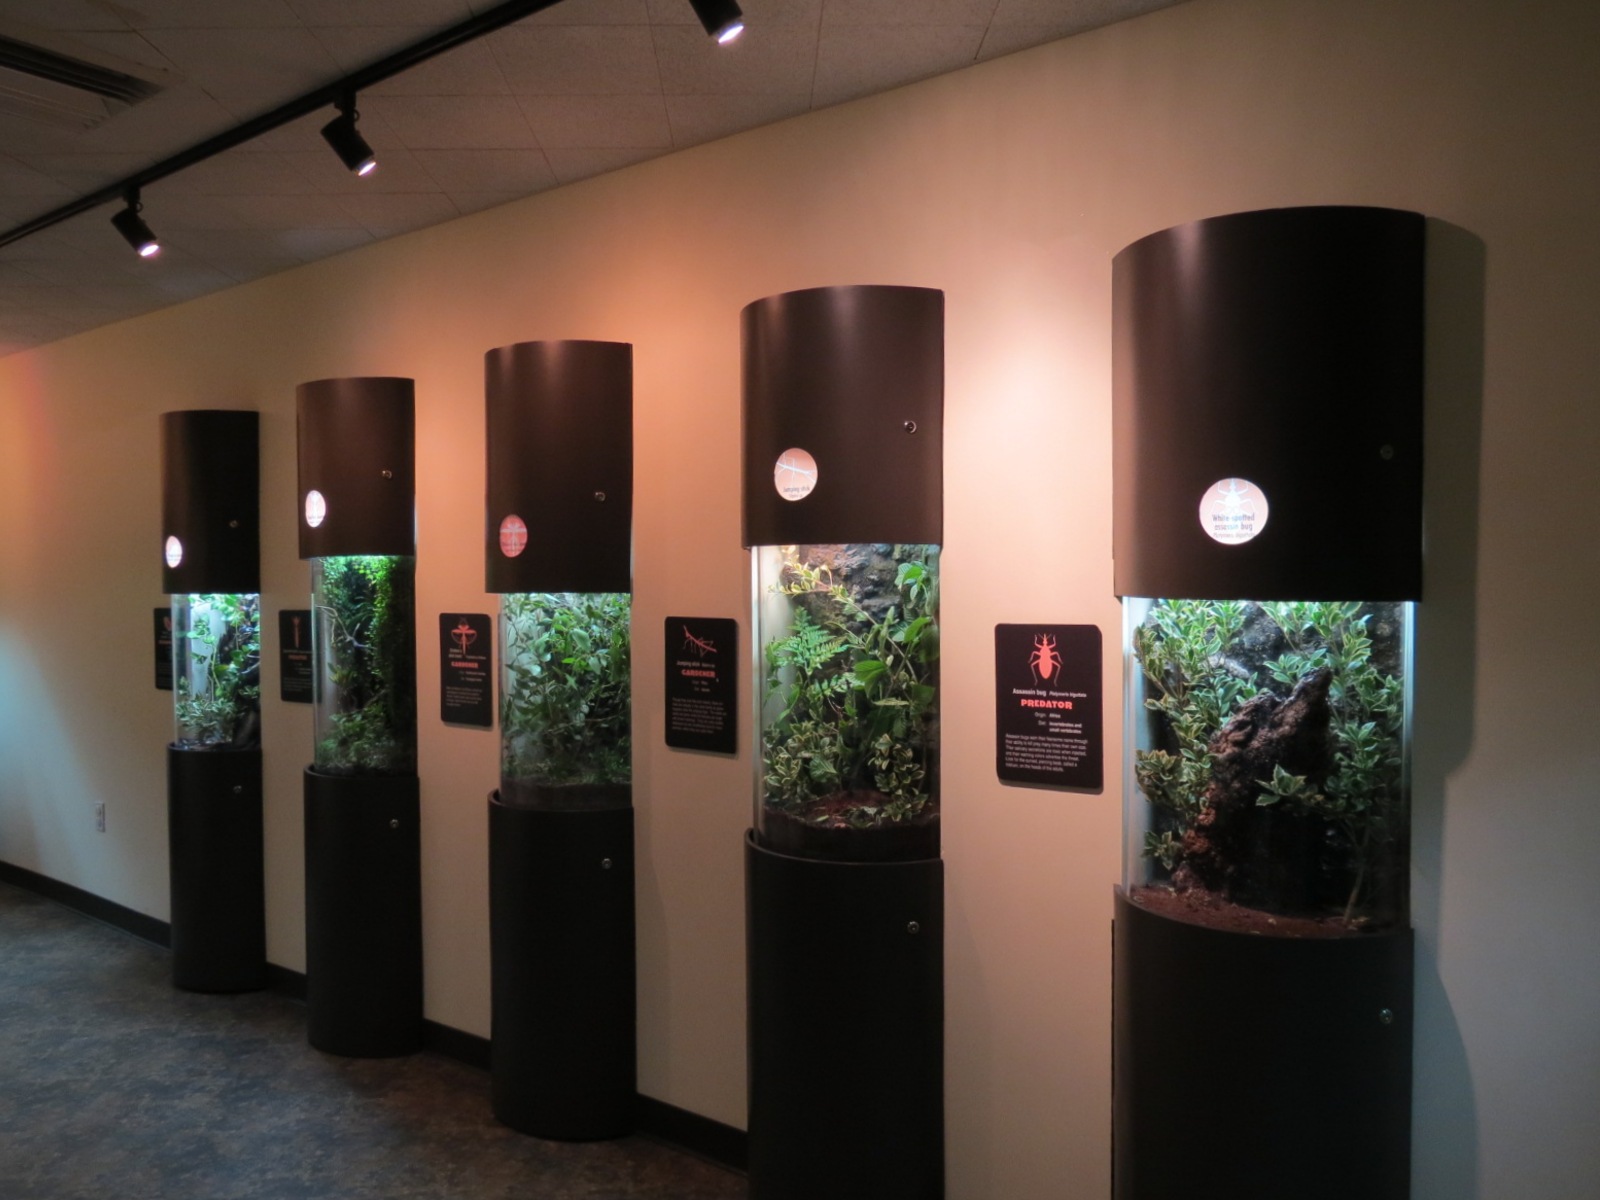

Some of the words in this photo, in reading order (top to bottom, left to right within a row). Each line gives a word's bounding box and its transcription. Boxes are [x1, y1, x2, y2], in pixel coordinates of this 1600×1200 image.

[1212, 514, 1229, 522] White
[1232, 512, 1254, 522] spotted
[1240, 522, 1252, 532] bug
[1036, 689, 1046, 697] bug
[1021, 699, 1072, 710] PREDATOR
